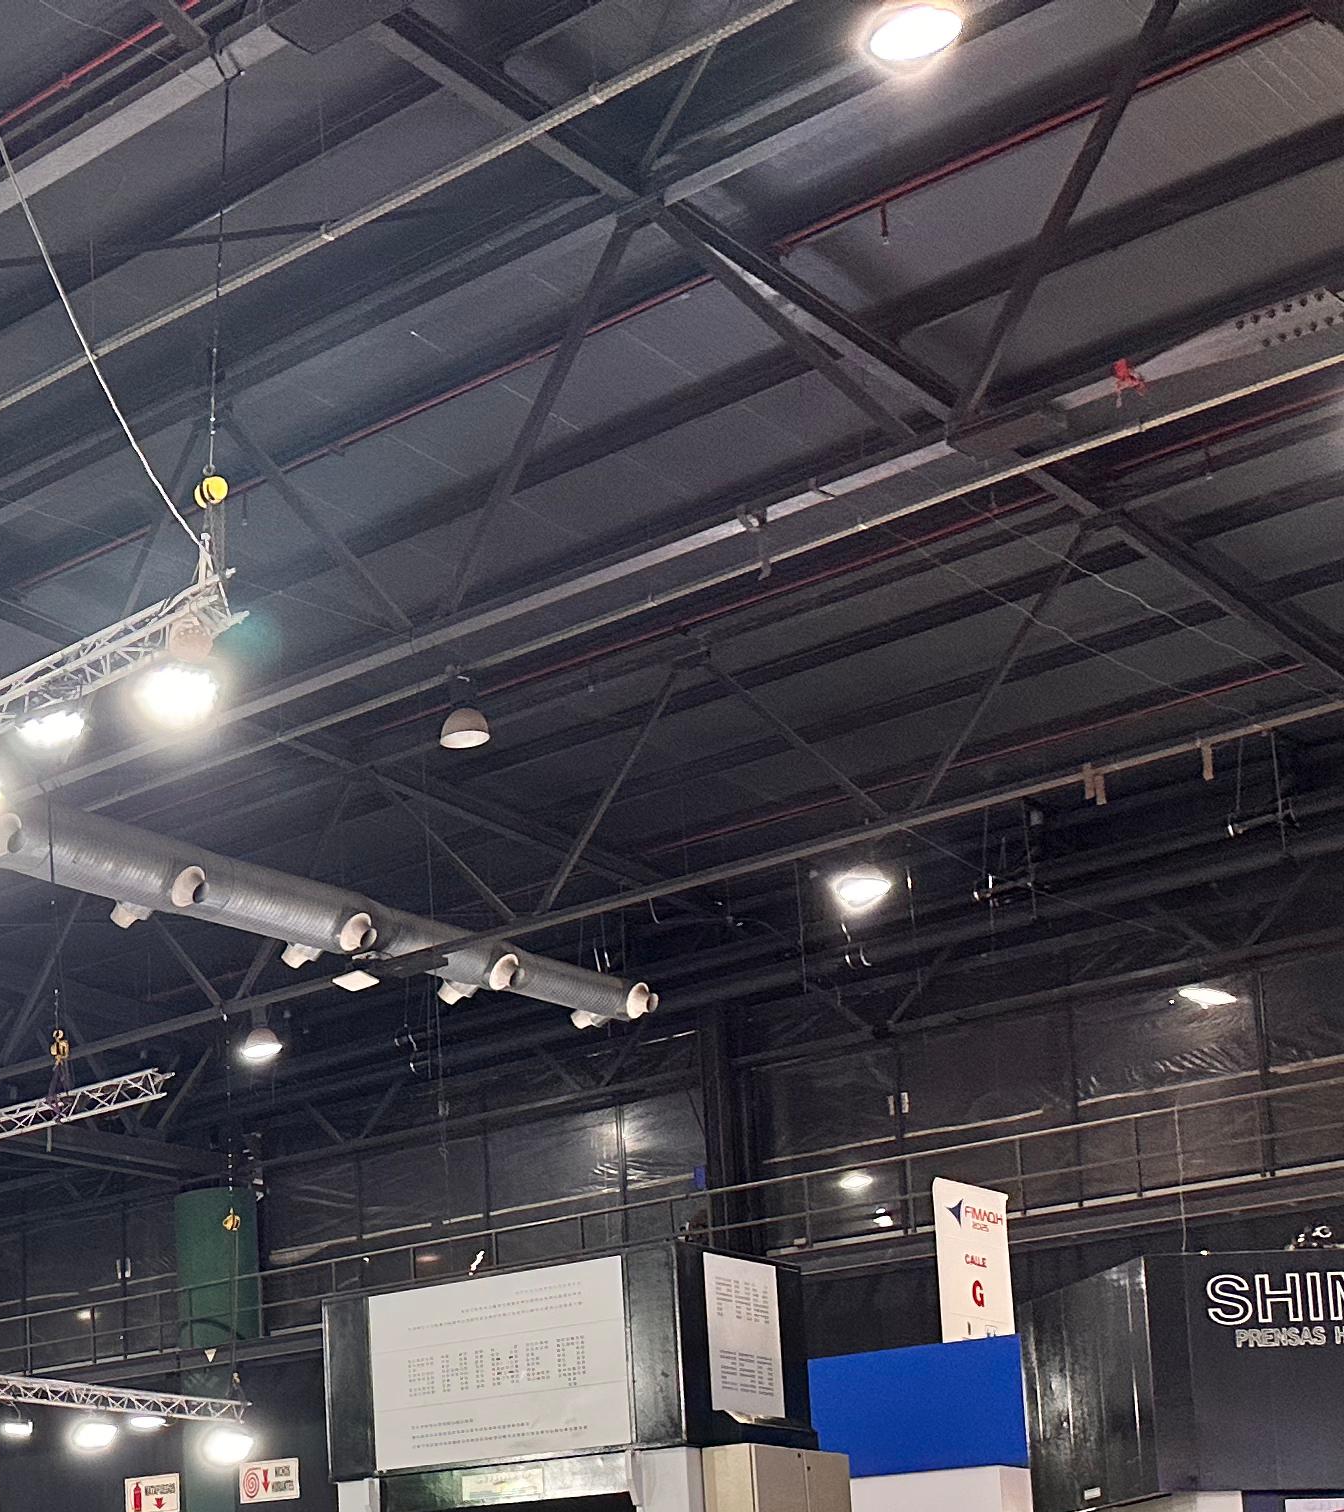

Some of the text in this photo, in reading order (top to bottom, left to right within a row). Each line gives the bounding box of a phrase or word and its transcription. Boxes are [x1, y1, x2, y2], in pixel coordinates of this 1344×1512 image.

[965, 1254, 988, 1268] CALLE
[972, 1280, 985, 1307] G
[1235, 1326, 1327, 1348] PRENSAS
[408, 1335, 587, 1397] SHIMEQ
